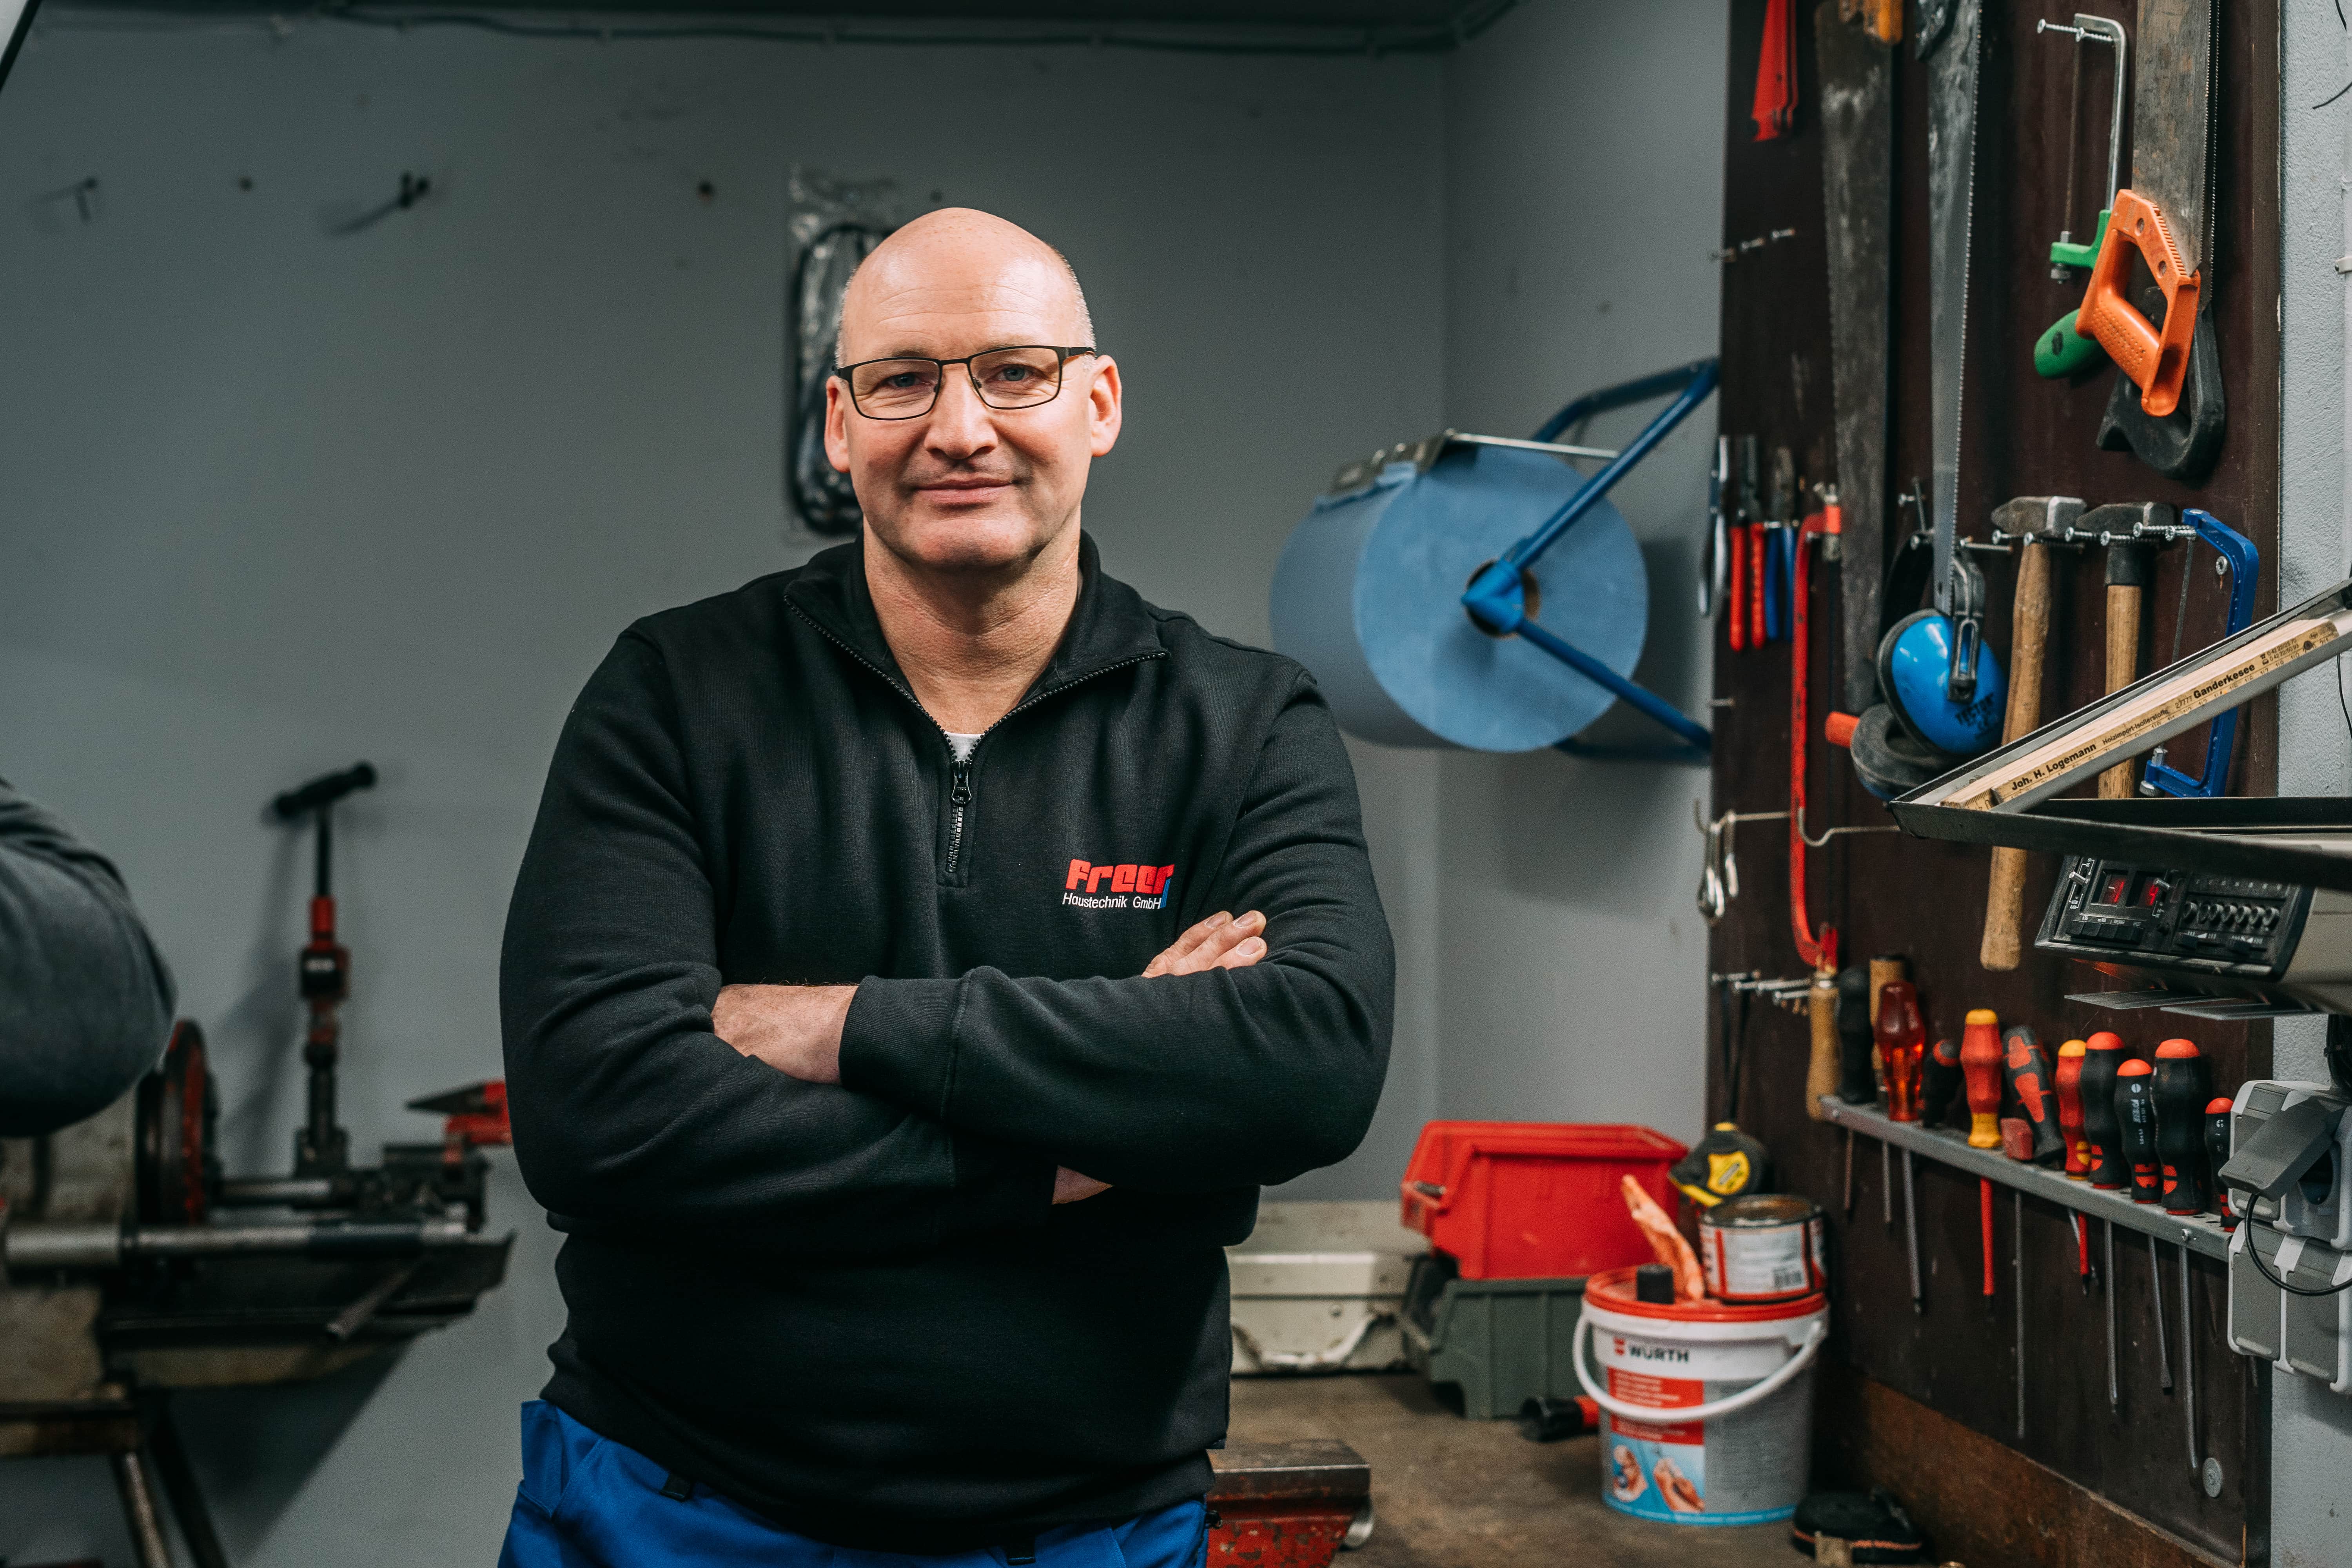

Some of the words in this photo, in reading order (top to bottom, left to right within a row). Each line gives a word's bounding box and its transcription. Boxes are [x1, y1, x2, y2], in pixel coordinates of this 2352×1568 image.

[2012, 777, 2032, 790] Joh.
[2033, 769, 2045, 779] H.
[2046, 744, 2096, 773] Logemann
[2175, 695, 2192, 709] 27777
[2194, 664, 2255, 699] Ganderkesee
[1062, 892, 1127, 909] Haustechnik
[1132, 896, 1162, 909] GmbH
